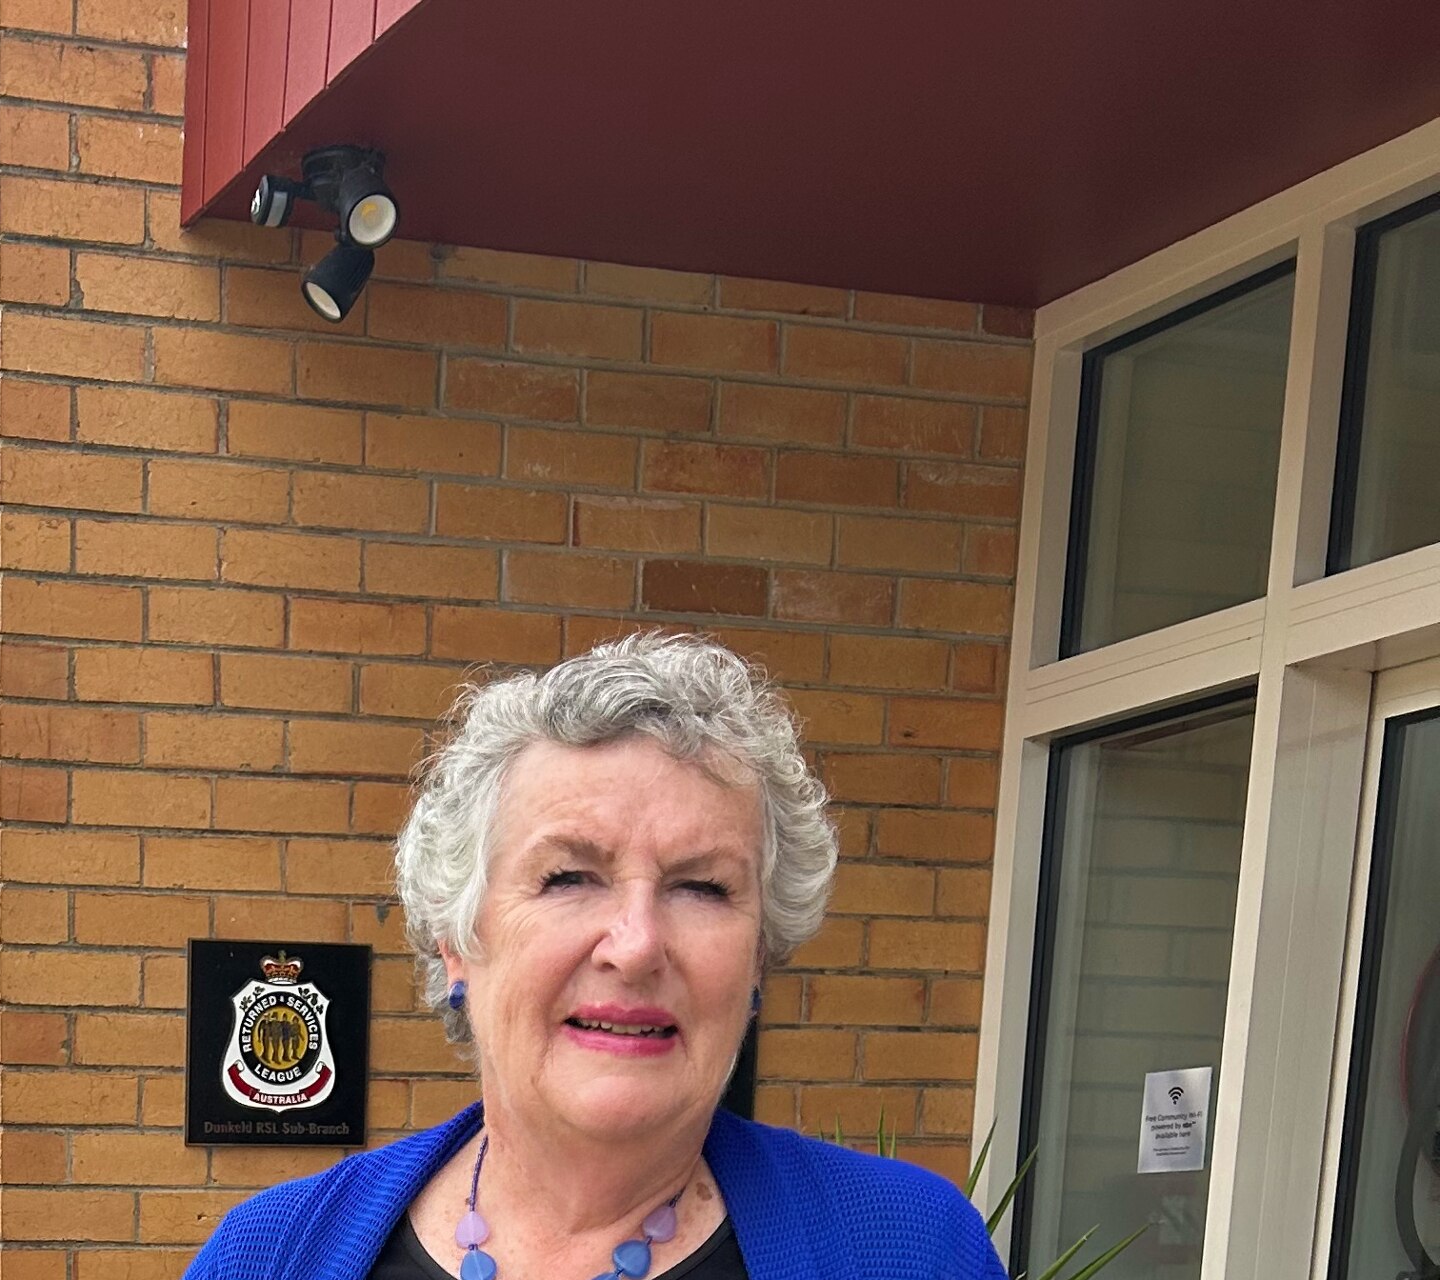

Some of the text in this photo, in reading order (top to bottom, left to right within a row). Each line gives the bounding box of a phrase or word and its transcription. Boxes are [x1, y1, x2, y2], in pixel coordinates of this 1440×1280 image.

[241, 995, 277, 1053] RETURNED
[286, 996, 319, 1050] SERVICES
[254, 1063, 302, 1082] LEAGUE
[253, 1092, 308, 1105] AUSTRALIA
[204, 1121, 350, 1135] Dunkeld RSL Sub-Branch
